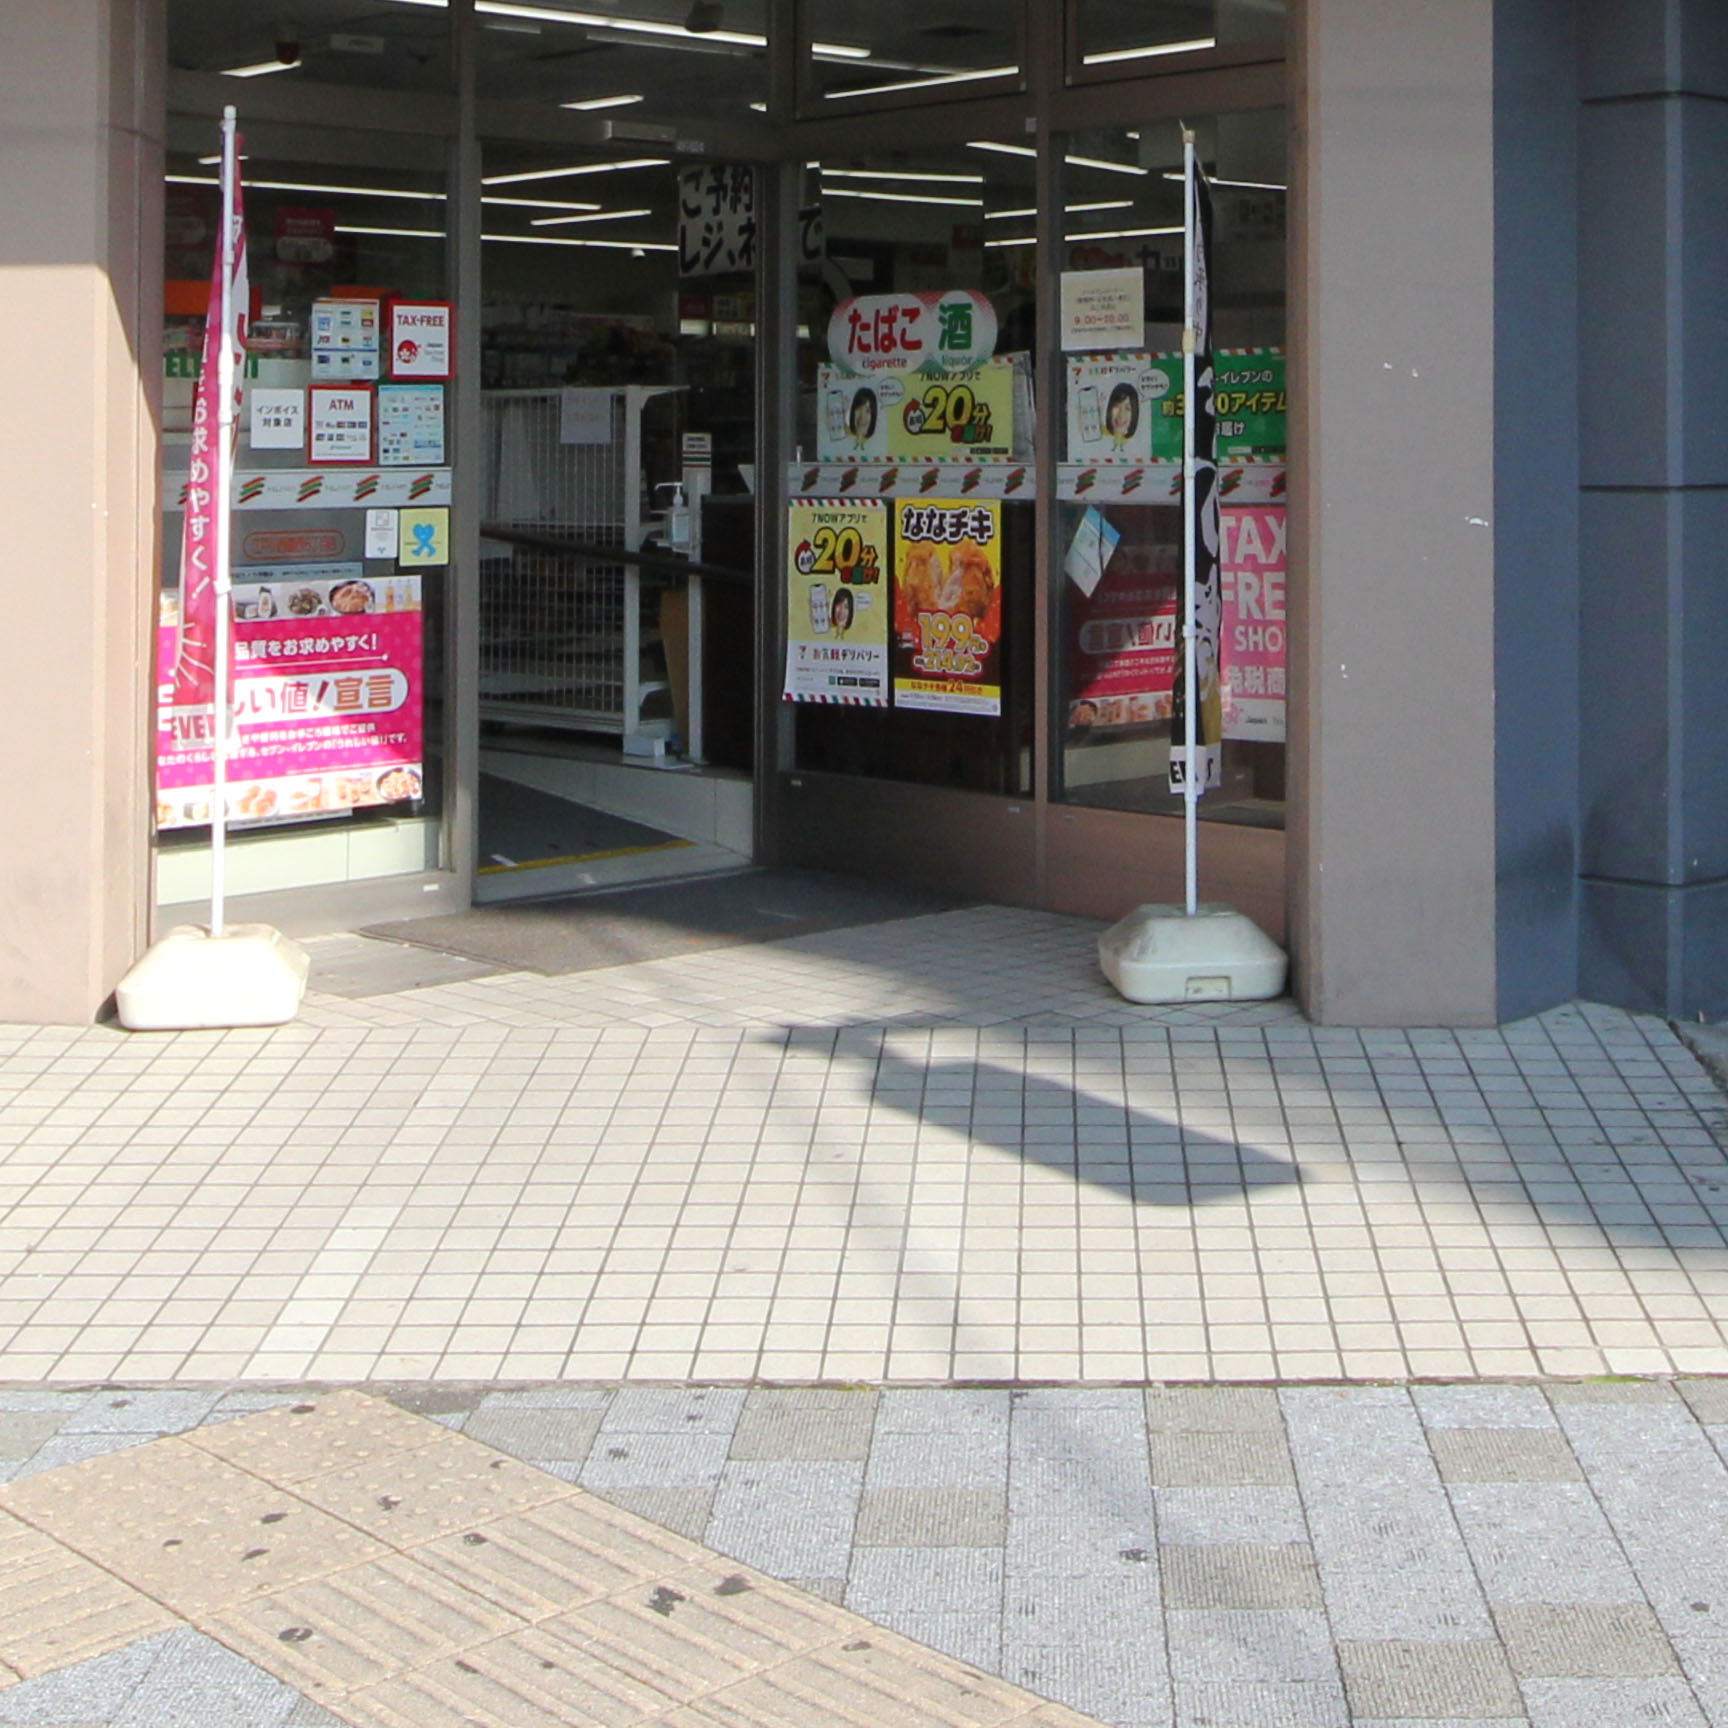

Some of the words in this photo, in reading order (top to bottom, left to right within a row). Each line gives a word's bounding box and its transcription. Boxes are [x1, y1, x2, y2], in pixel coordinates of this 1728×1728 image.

[848, 305, 923, 354] たばこ
[938, 303, 972, 350] 酒
[328, 398, 354, 412] ATM
[902, 506, 994, 543] ななチキ
